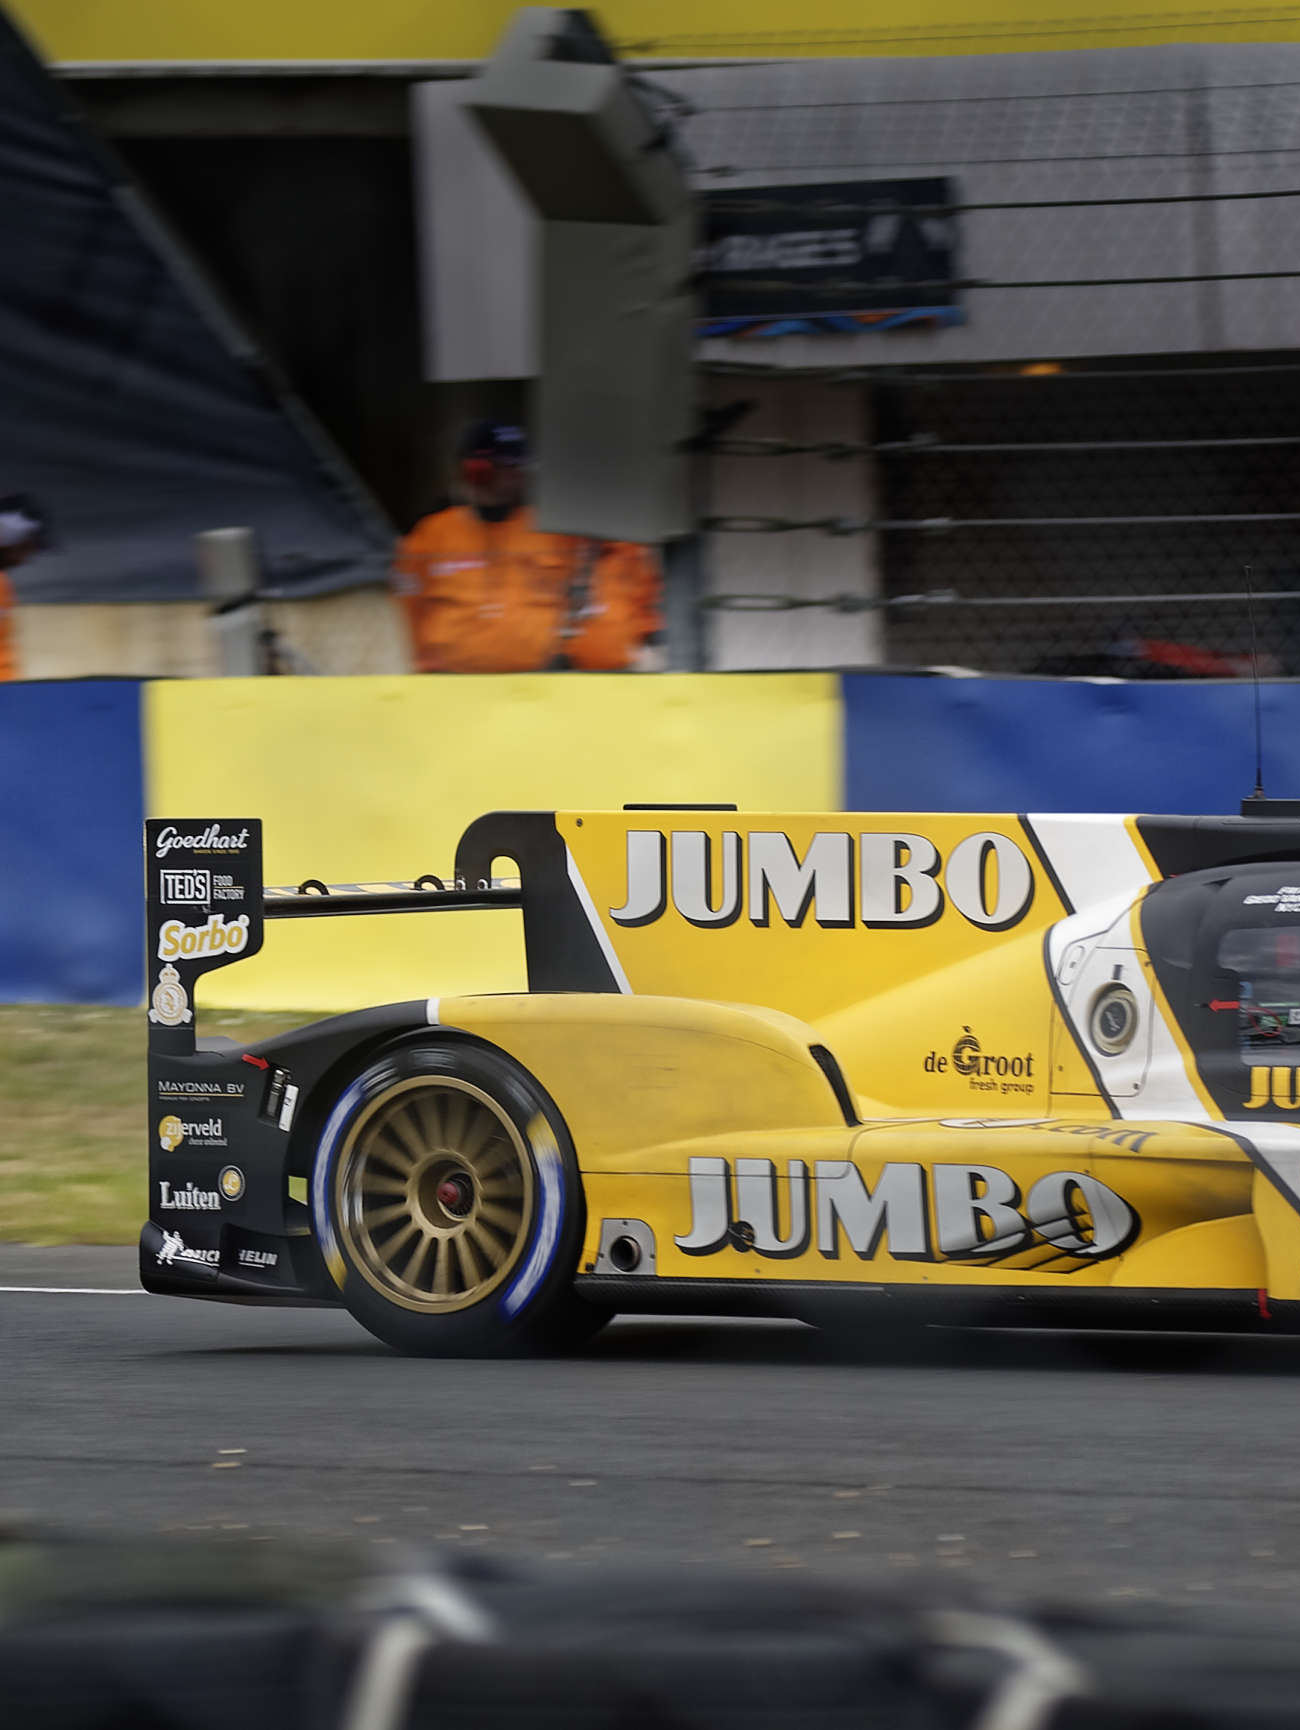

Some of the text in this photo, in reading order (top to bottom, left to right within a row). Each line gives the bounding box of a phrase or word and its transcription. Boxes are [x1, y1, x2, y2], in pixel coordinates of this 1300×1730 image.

[155, 823, 250, 858] Goedhart
[164, 871, 206, 899] TED'S
[608, 830, 1035, 932] JUMBO
[162, 919, 244, 957] Sorbo
[924, 1033, 1034, 1077] de Groot
[158, 1081, 244, 1093] MAYONNA BV
[159, 1181, 222, 1211] Luiten
[674, 1156, 1140, 1262] JUMBO
